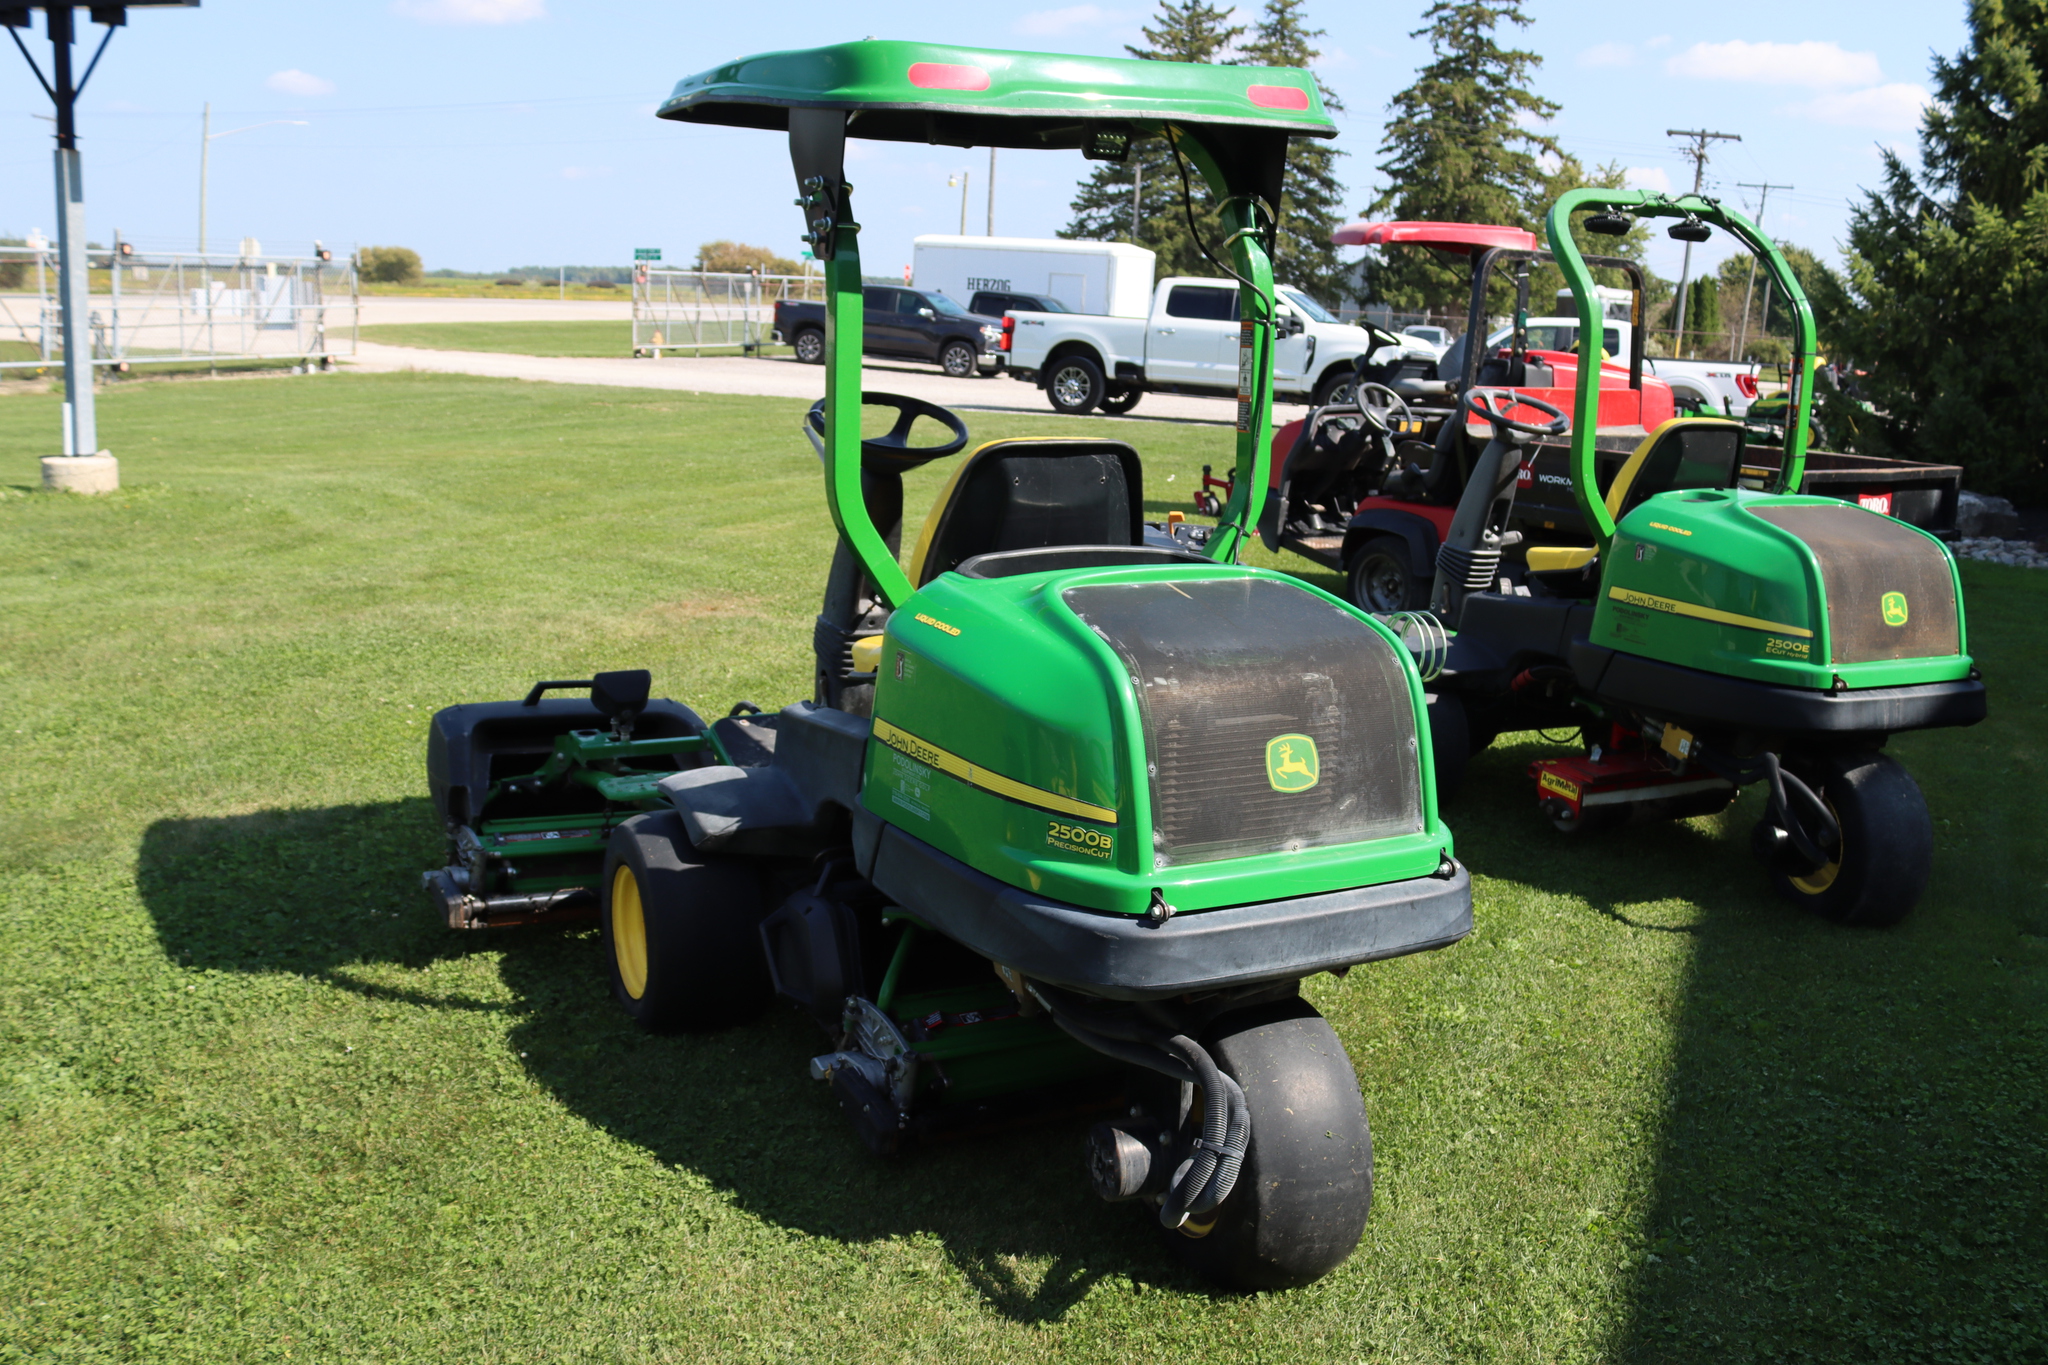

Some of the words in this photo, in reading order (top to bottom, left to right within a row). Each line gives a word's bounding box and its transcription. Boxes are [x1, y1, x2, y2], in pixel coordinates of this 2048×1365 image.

[967, 277, 1011, 291] HERZOG
[1518, 469, 1531, 480] RO
[1539, 474, 1573, 486] WORKM
[1860, 497, 1888, 513] TORO
[1649, 521, 1668, 530] LIQUID
[1668, 526, 1692, 536] COOLED
[1624, 592, 1646, 605] JOHN
[1648, 597, 1676, 611] DEERE
[914, 612, 936, 626] LIQUID
[934, 621, 961, 637] COOLED
[1767, 638, 1810, 653] 2500E
[886, 729, 908, 751] JOHN
[910, 740, 940, 766] DEERE
[893, 753, 931, 779] PODOLINSKY
[1048, 821, 1112, 849] 2500B
